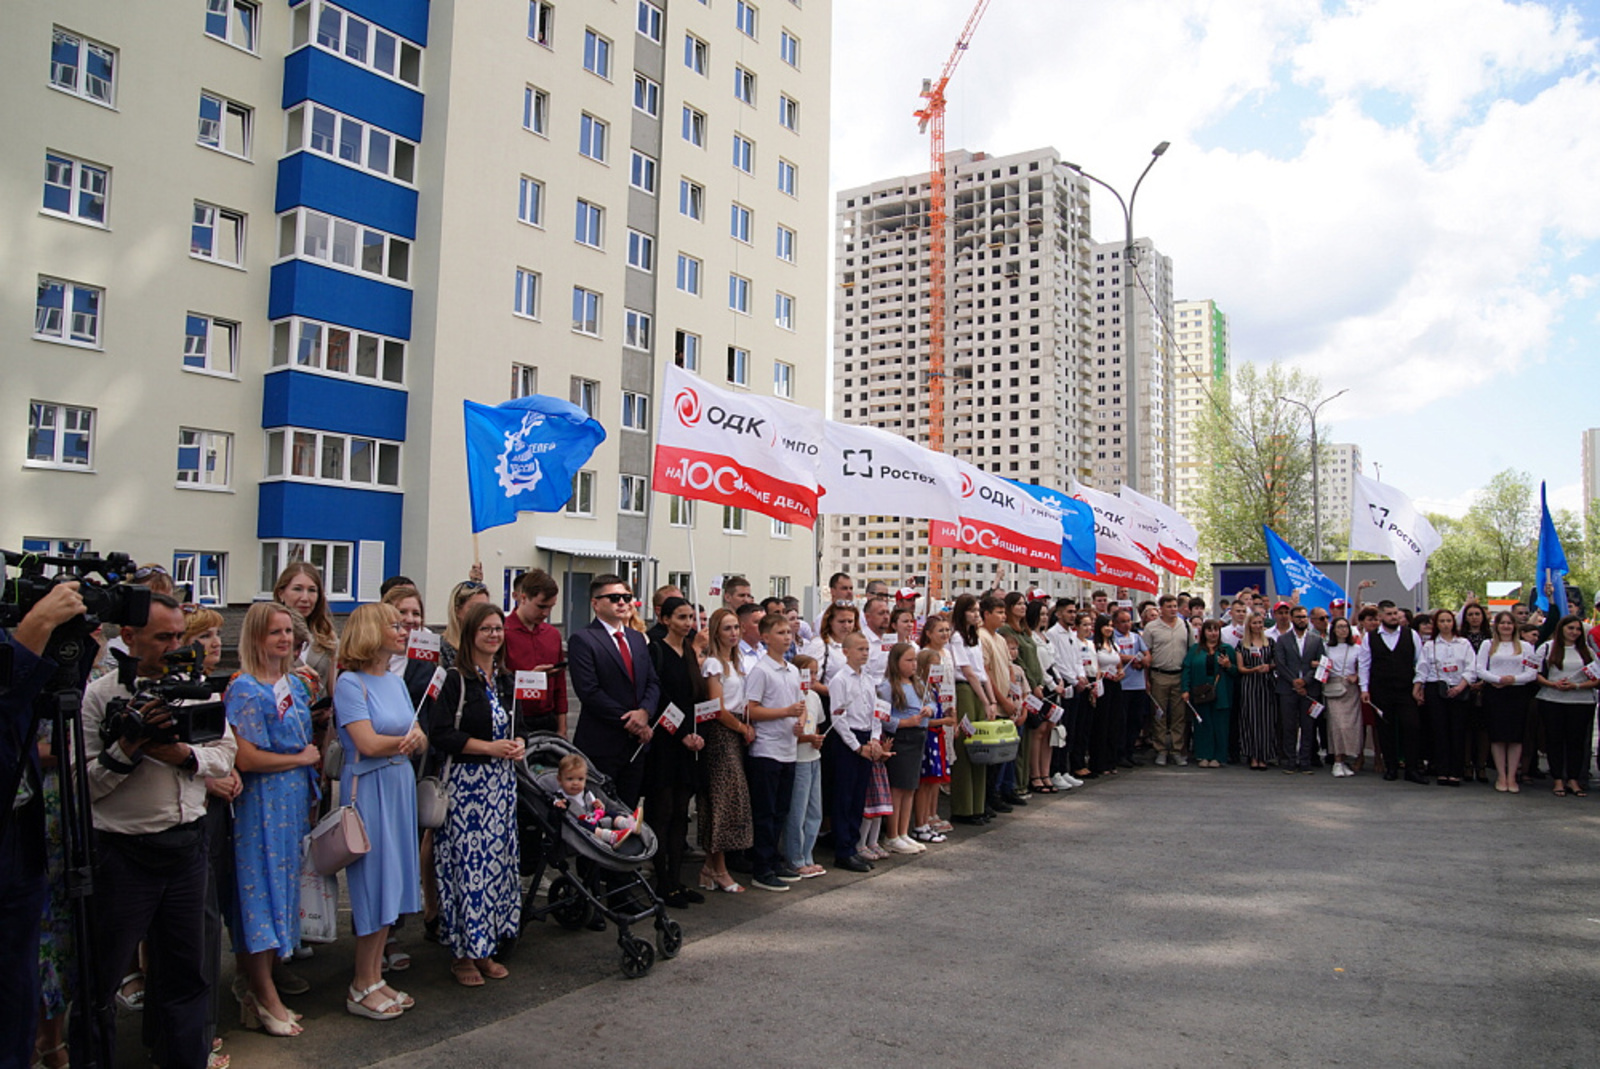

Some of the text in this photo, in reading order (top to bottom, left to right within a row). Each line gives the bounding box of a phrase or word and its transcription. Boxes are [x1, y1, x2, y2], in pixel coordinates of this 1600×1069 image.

[706, 405, 766, 439] ОДК
[880, 465, 937, 486] Ростех
[979, 486, 1016, 510] ОДК
[1388, 523, 1421, 556] Ростех
